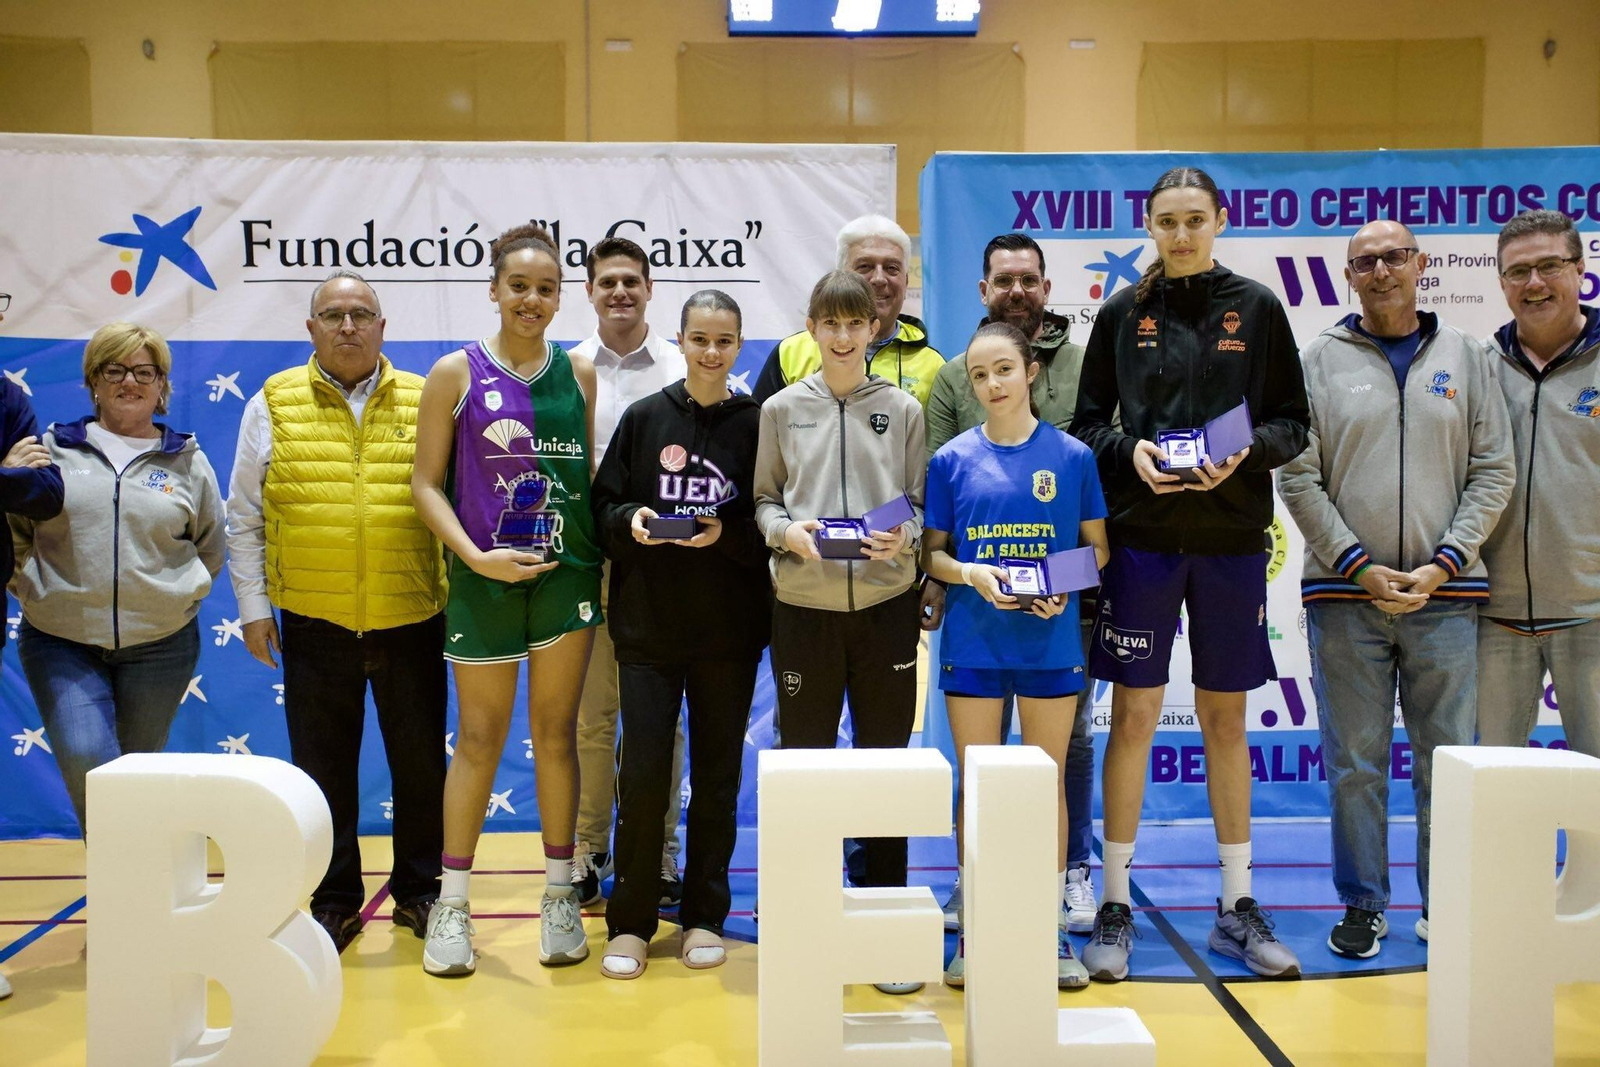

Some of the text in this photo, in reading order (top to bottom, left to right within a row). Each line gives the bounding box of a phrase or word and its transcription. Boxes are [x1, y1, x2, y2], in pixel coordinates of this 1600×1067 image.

[1012, 190, 1114, 231] XVIII
[1124, 188, 1300, 230] TNEO
[1432, 295, 1447, 304] en
[1450, 293, 1484, 304] forma
[1350, 383, 1372, 394] vive
[530, 436, 583, 456] Unicaja
[69, 468, 91, 476] vive
[659, 473, 736, 503] UEM
[976, 543, 1048, 559] LA SALLE
[1104, 628, 1148, 649] PULEVA
[86, 752, 341, 1067] B
